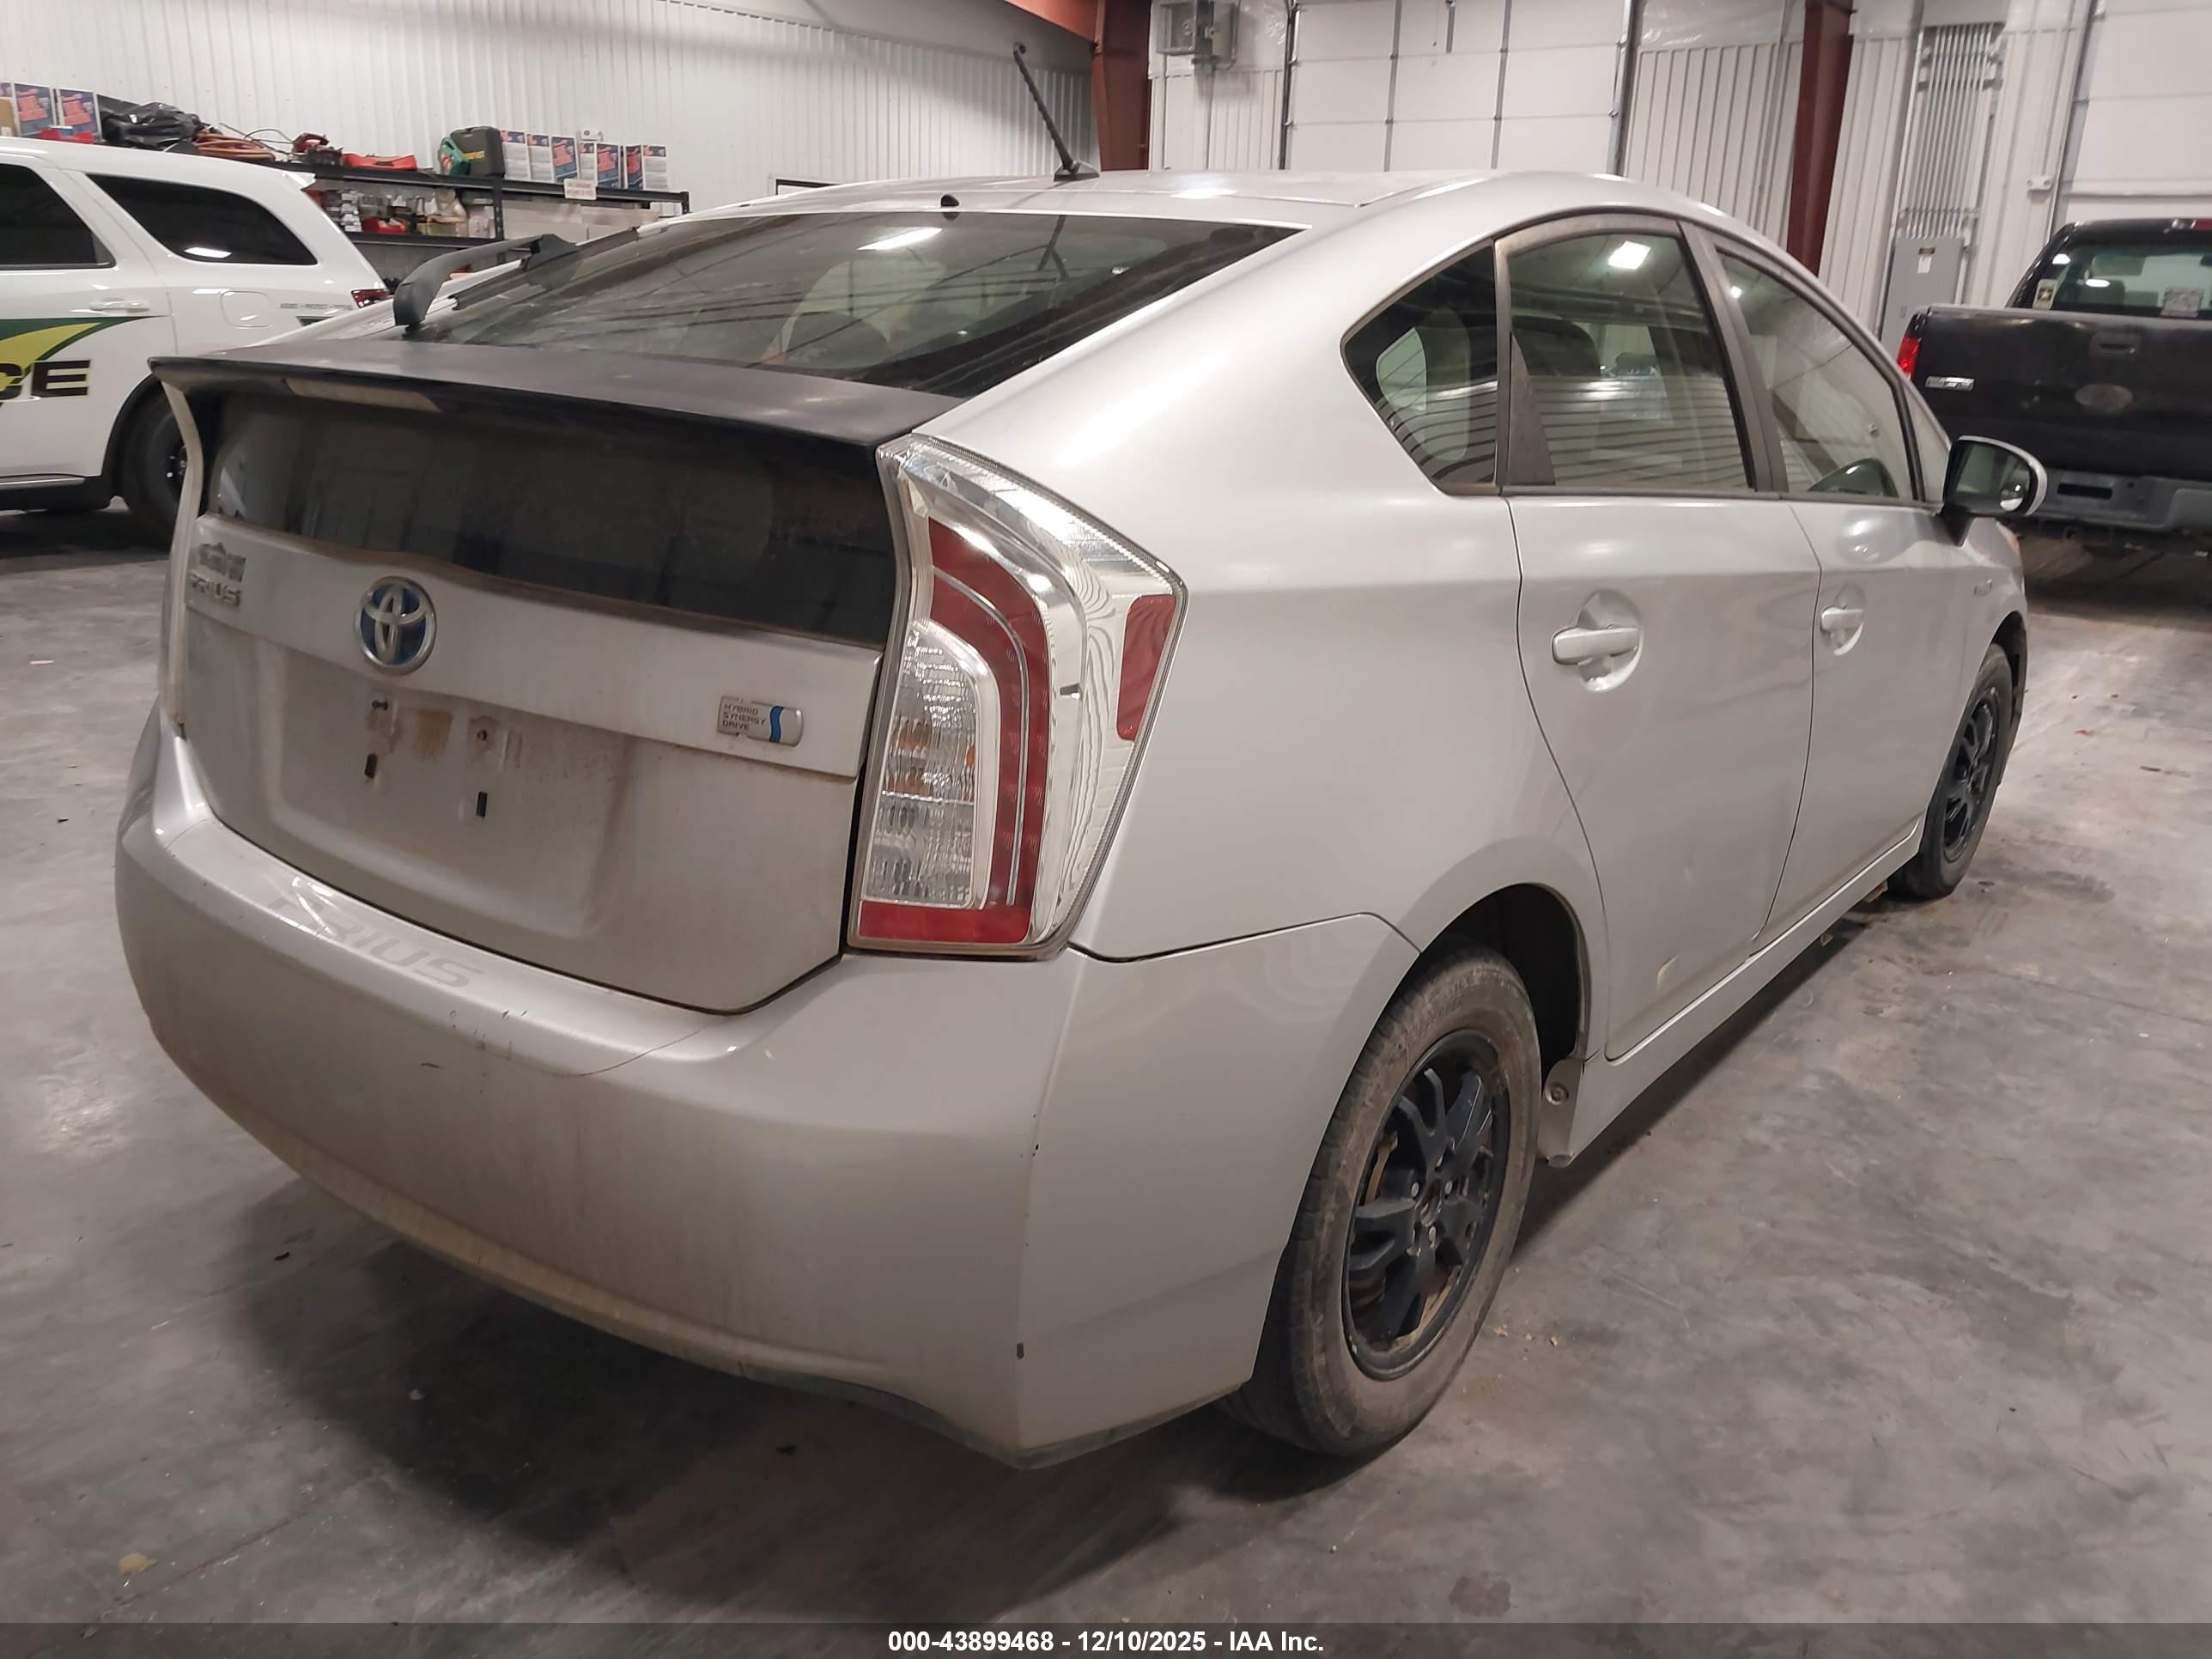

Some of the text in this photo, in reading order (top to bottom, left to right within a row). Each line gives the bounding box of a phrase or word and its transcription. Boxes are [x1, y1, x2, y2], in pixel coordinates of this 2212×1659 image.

[724, 704, 759, 715] HYBRID
[722, 712, 766, 726] SYNERGY
[722, 720, 749, 731] DRIVE
